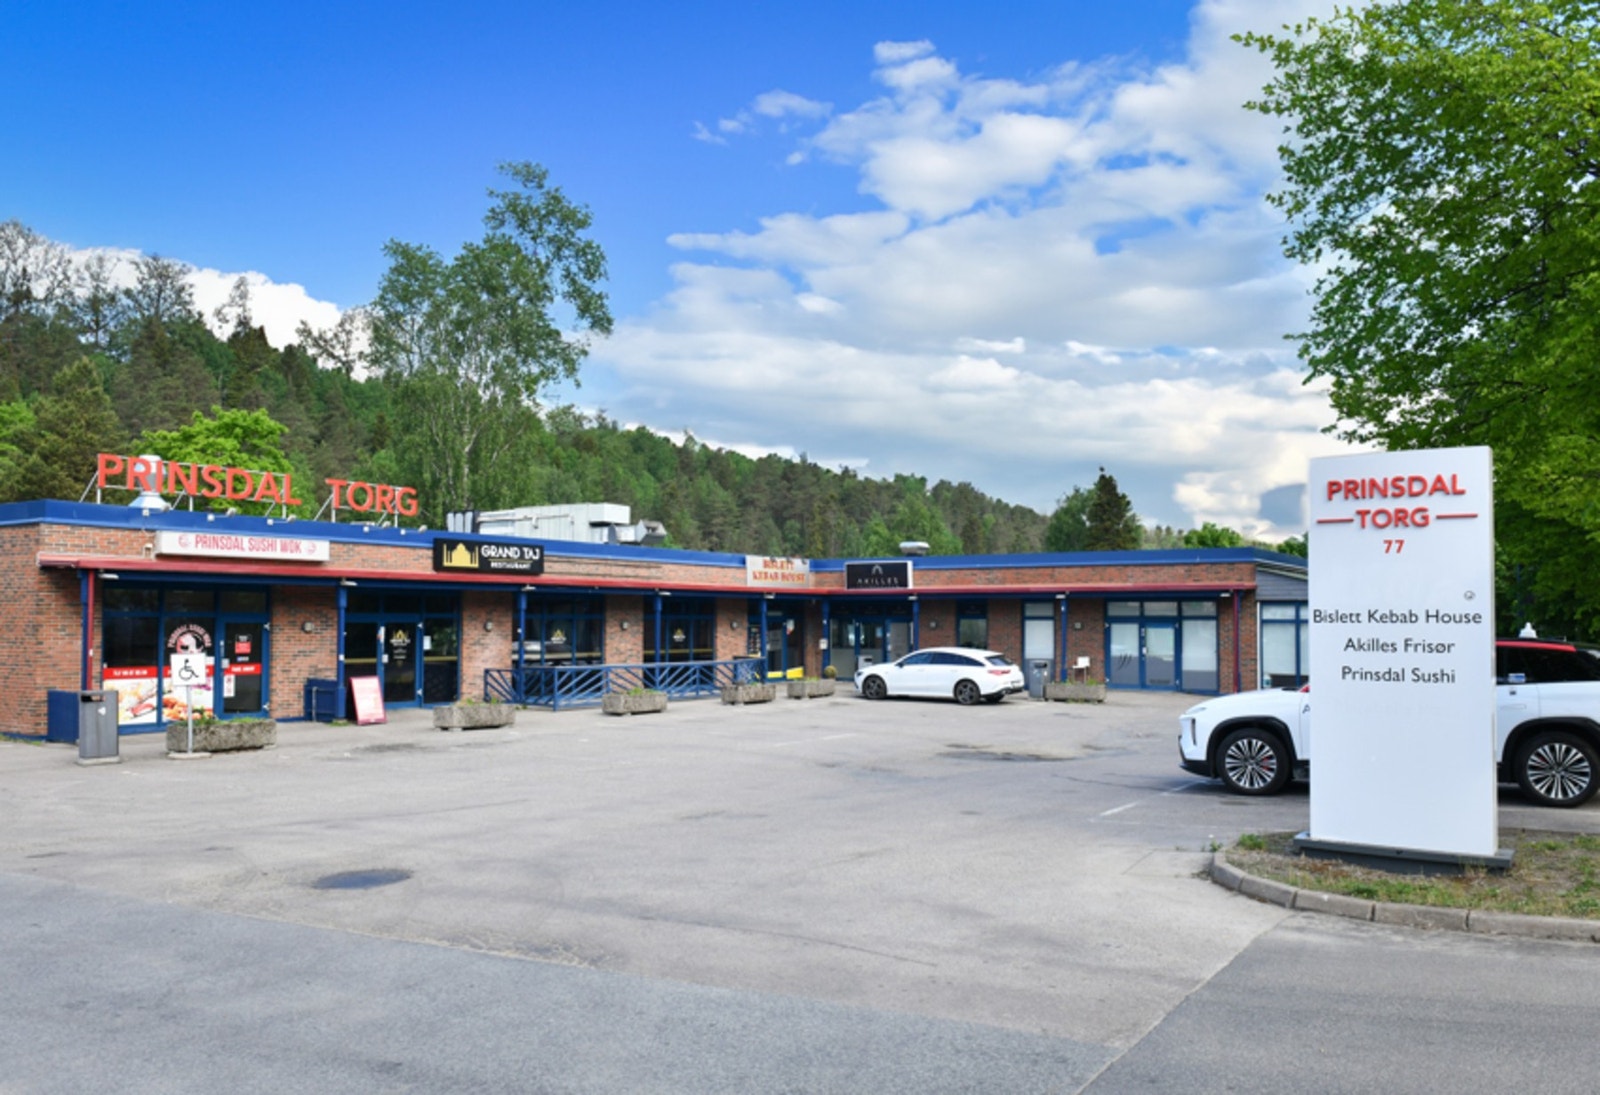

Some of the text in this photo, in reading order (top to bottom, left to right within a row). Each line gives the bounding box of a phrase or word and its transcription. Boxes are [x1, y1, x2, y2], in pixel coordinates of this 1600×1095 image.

[97, 453, 419, 516] PRINSDAL TORG
[1327, 474, 1466, 501] PRINSDAL
[1355, 507, 1431, 529] TORG
[194, 534, 302, 554] PRINSDAL SUSHI WOK
[481, 544, 540, 560] GRAND TAJ
[1383, 539, 1405, 554] 77
[490, 561, 531, 570] RESTAURANT
[752, 571, 805, 583] KEBAB HOUSE
[857, 577, 899, 585] AKILLES
[1313, 609, 1482, 624] Bislett Kebab House
[1343, 637, 1455, 653] Akilles Frisør
[1342, 666, 1455, 683] Prinsdal Sushi
